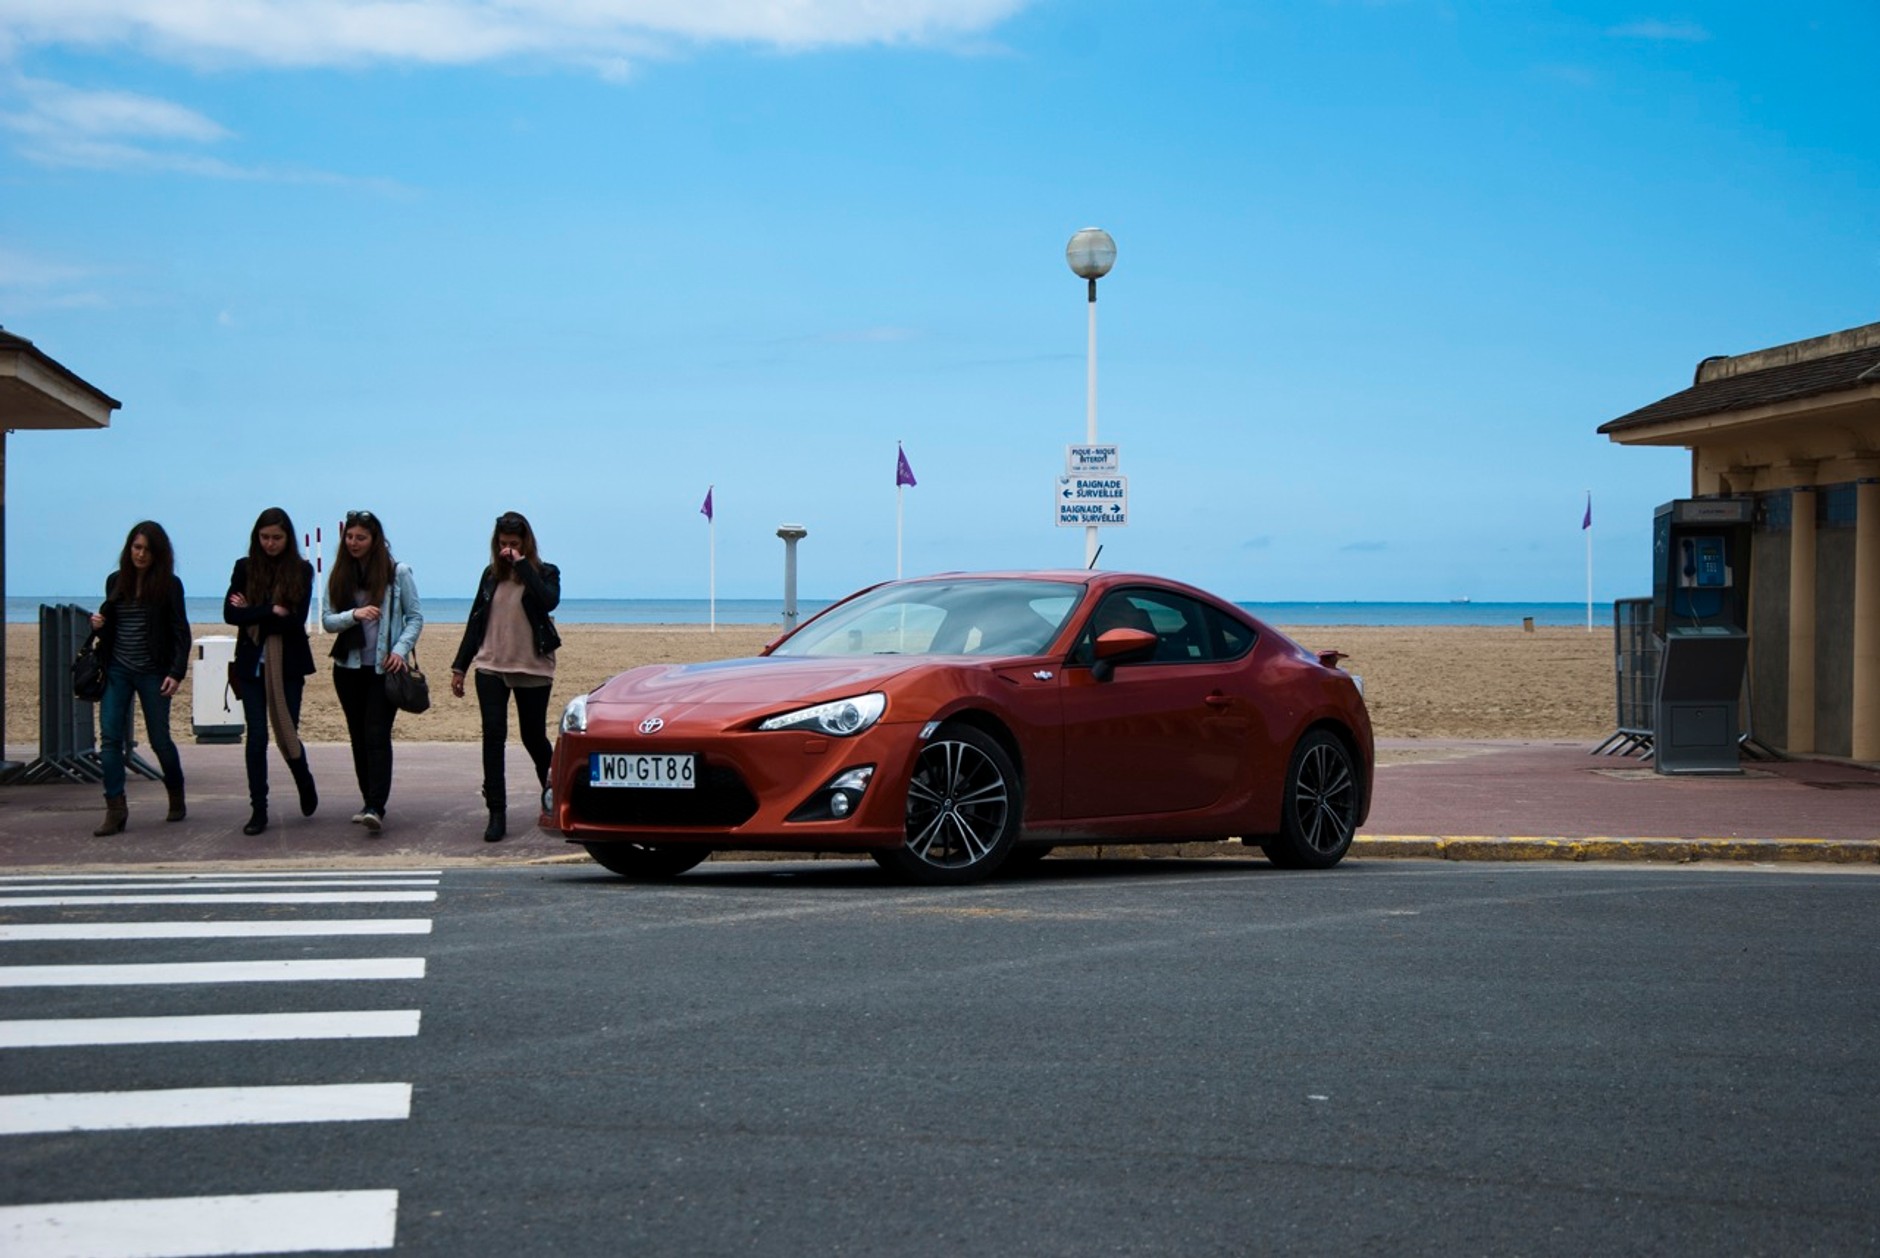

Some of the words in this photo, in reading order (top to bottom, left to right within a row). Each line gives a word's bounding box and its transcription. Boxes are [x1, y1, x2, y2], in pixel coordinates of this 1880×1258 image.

[1080, 454, 1107, 463] INTERDIT
[1077, 480, 1121, 488] BAIGNADE
[1061, 505, 1103, 513] BAIGNADE
[1060, 514, 1079, 522] NON
[603, 757, 627, 780] WO
[637, 757, 692, 780] GT86
